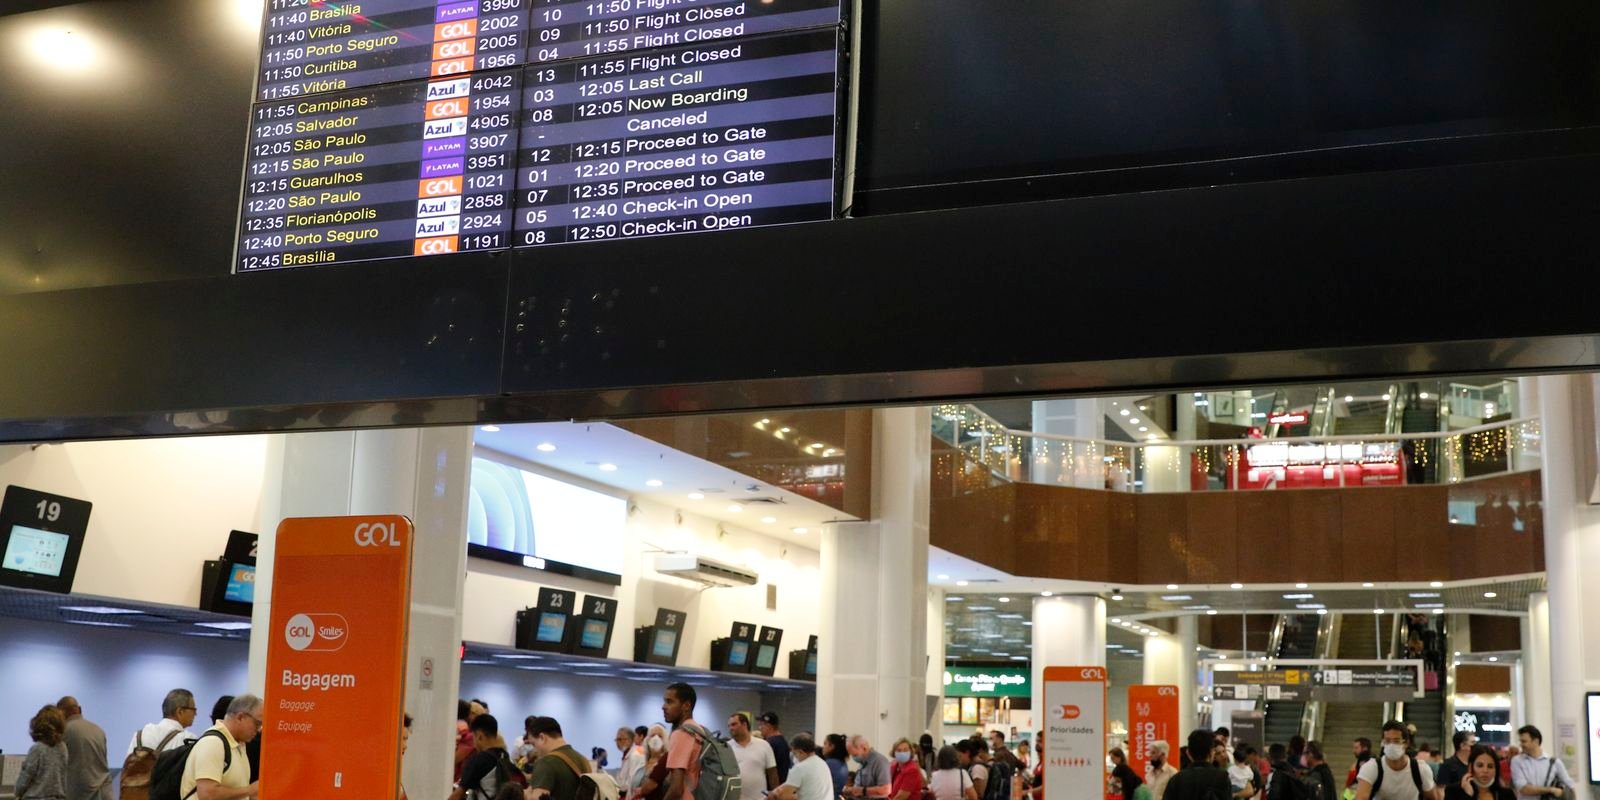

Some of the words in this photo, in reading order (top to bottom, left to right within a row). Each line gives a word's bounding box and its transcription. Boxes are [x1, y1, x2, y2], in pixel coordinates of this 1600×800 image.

[266, 48, 303, 64] 11:50
[306, 42, 343, 57] Porto
[347, 34, 398, 54] Seguro
[441, 22, 471, 39] GOL
[480, 15, 519, 31] 2002
[543, 9, 562, 22] 10
[586, 0, 630, 16] 11:50
[268, 30, 305, 46] 11:40
[308, 23, 352, 39] Vitória
[446, 6, 474, 16] LATAM
[482, 0, 520, 12] 3990
[270, 12, 307, 27] 11:40
[310, 4, 361, 21] Brasília
[264, 66, 301, 82] 11:50
[304, 59, 357, 76] Curitiba
[439, 41, 470, 57] GOL
[478, 34, 517, 50] 2005
[540, 28, 561, 42] 09
[585, 20, 630, 36] 11:50
[635, 13, 680, 31] Flight
[685, 4, 746, 22] Closed
[262, 84, 299, 100] 11:55
[302, 78, 346, 94] Vitória
[437, 60, 468, 75] GOL
[479, 54, 516, 69] 1956
[538, 48, 559, 61] 04
[584, 40, 628, 54] 11:55
[634, 32, 680, 48] Flight
[684, 23, 745, 42] Closed
[257, 104, 294, 120] 11:55
[297, 96, 368, 116] Campinas
[428, 84, 456, 98] Azul
[474, 75, 512, 90] 4042
[536, 70, 555, 82] 13
[580, 62, 625, 77] 11:55
[630, 52, 676, 72] Flight
[680, 45, 742, 64] Closed
[255, 122, 292, 138] 12:05
[295, 116, 358, 134] Salvador
[432, 100, 463, 116] GOL
[473, 94, 510, 110] 1954
[534, 90, 554, 103] 03
[578, 80, 624, 98] 12:05
[629, 76, 664, 91] Last
[668, 70, 703, 87] Call
[253, 142, 291, 157] 12:05
[294, 136, 320, 152] São
[325, 133, 366, 148] Paulo
[425, 122, 452, 137] Azul
[470, 114, 510, 128] 4905
[532, 109, 553, 122] 08
[578, 102, 624, 118] 12:05
[628, 96, 666, 112] Now
[672, 87, 748, 108] Boarding
[250, 180, 288, 194] 12:15
[290, 170, 362, 190] Guarulhos
[432, 162, 460, 171] LATAM
[468, 154, 506, 169] 3951
[530, 149, 550, 162] 12
[576, 142, 620, 158] 12:15
[626, 132, 696, 152] Proceed
[702, 131, 719, 144] to
[724, 126, 766, 142] Gate
[251, 160, 289, 176] 12:15
[292, 156, 319, 171] São
[324, 152, 364, 166] Paulo
[434, 143, 460, 152] LATAM
[469, 134, 508, 150] 3907
[627, 112, 708, 132] Canceled
[248, 198, 286, 213] 12:20
[288, 193, 314, 209] São
[320, 190, 361, 204] Paulo
[425, 179, 457, 194] GOL
[467, 174, 504, 189] 1021
[528, 170, 548, 184] 01
[574, 162, 620, 178] 12:20
[625, 153, 696, 173] Proceed
[700, 152, 718, 165] to
[723, 147, 766, 162] Gate
[246, 216, 284, 232] 12:35
[286, 208, 376, 228] Florianópolis
[418, 200, 446, 214] Azul
[464, 194, 504, 209] 2858
[527, 190, 548, 204] 07
[572, 182, 619, 199] 12:35
[623, 174, 695, 194] Proceed
[700, 173, 718, 186] to
[722, 168, 765, 184] Gate
[244, 236, 282, 251] 12:40
[284, 230, 322, 246] Porto
[326, 226, 378, 244] Seguro
[416, 220, 445, 234] Azul
[462, 214, 502, 230] 2924
[526, 210, 548, 224] 05
[572, 204, 618, 220] 12:40
[622, 198, 698, 216] Check-in
[704, 191, 753, 208] Open
[242, 254, 280, 270] 12:45
[282, 250, 336, 267] Brasília
[422, 241, 452, 255] GOL
[462, 234, 500, 249] 1191
[524, 231, 546, 244] 08
[570, 224, 617, 241] 12:50
[621, 218, 697, 237] Check-in
[702, 212, 752, 230] Open
[36, 500, 60, 521] 19
[354, 522, 400, 547] GOL
[550, 593, 563, 608] 23
[594, 600, 606, 614] 24
[289, 626, 310, 638] GOL
[318, 626, 344, 638] Smiles
[665, 613, 677, 626] 25
[282, 669, 356, 690] Bagagem
[1080, 668, 1103, 680] GOL
[1158, 686, 1177, 696] GOL
[280, 699, 315, 712] Baggage
[278, 720, 312, 734] Equipaje
[1050, 726, 1094, 734] Prioridades
